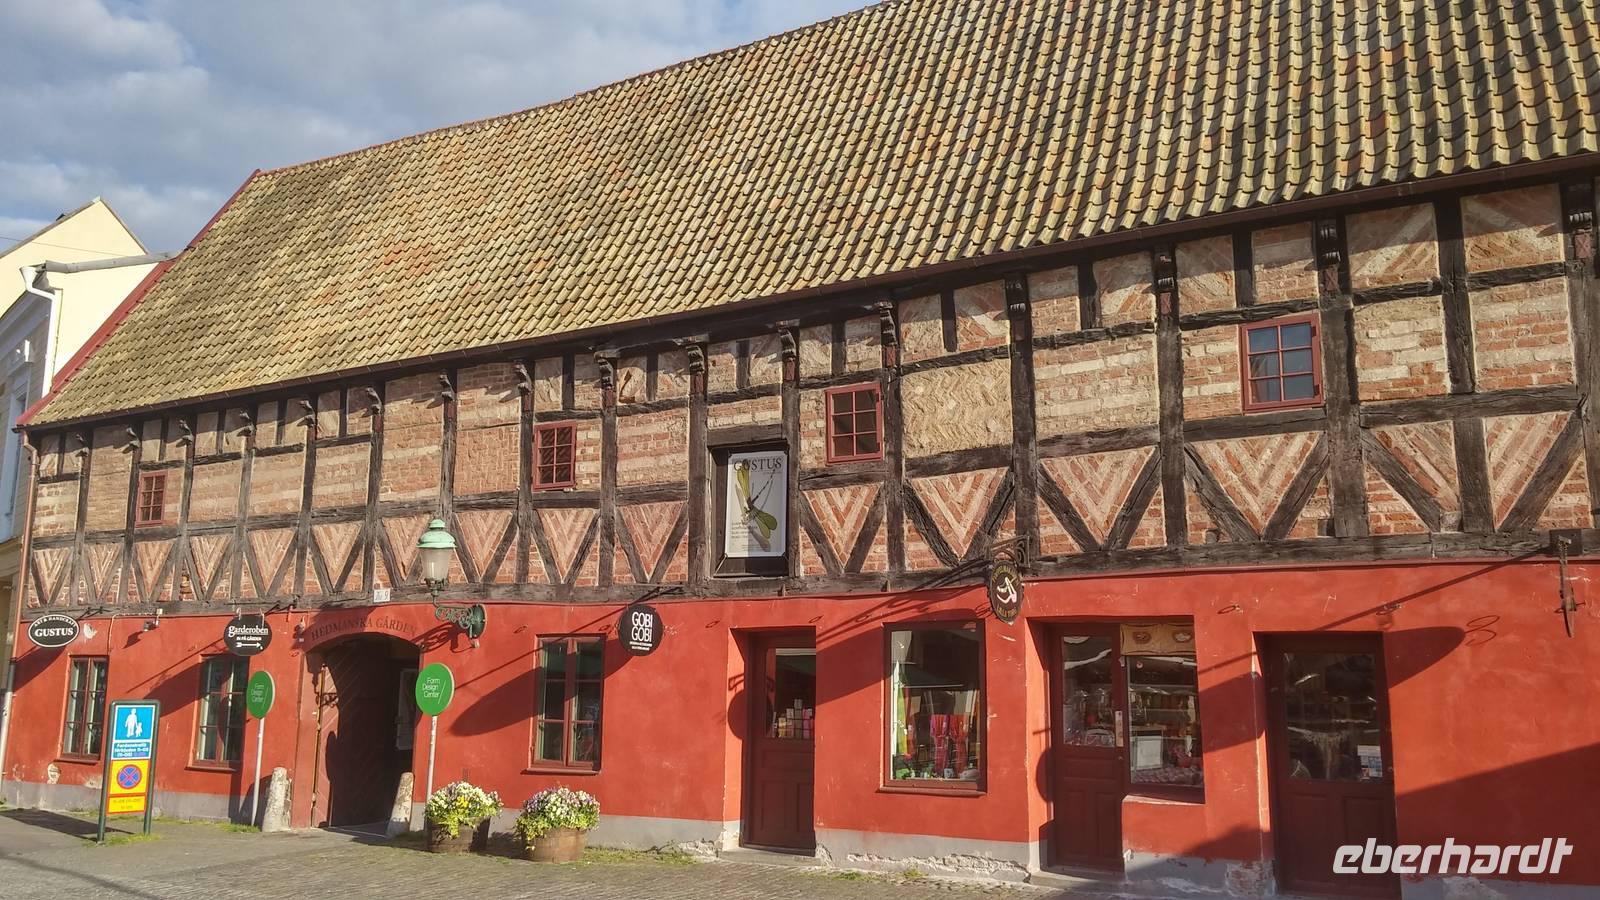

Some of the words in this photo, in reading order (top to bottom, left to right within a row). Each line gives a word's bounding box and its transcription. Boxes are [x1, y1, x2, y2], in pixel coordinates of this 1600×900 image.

[733, 458, 782, 472] GUSTUS
[631, 611, 653, 628] GOBI
[34, 627, 74, 637] GUSTUS
[228, 624, 269, 638] garderoben
[311, 617, 373, 641] HEDMANSKA
[375, 615, 418, 637] GÅRDEN
[631, 626, 653, 643] GOBI
[423, 683, 439, 692] Design
[426, 677, 440, 685] Form
[423, 690, 440, 698] Center
